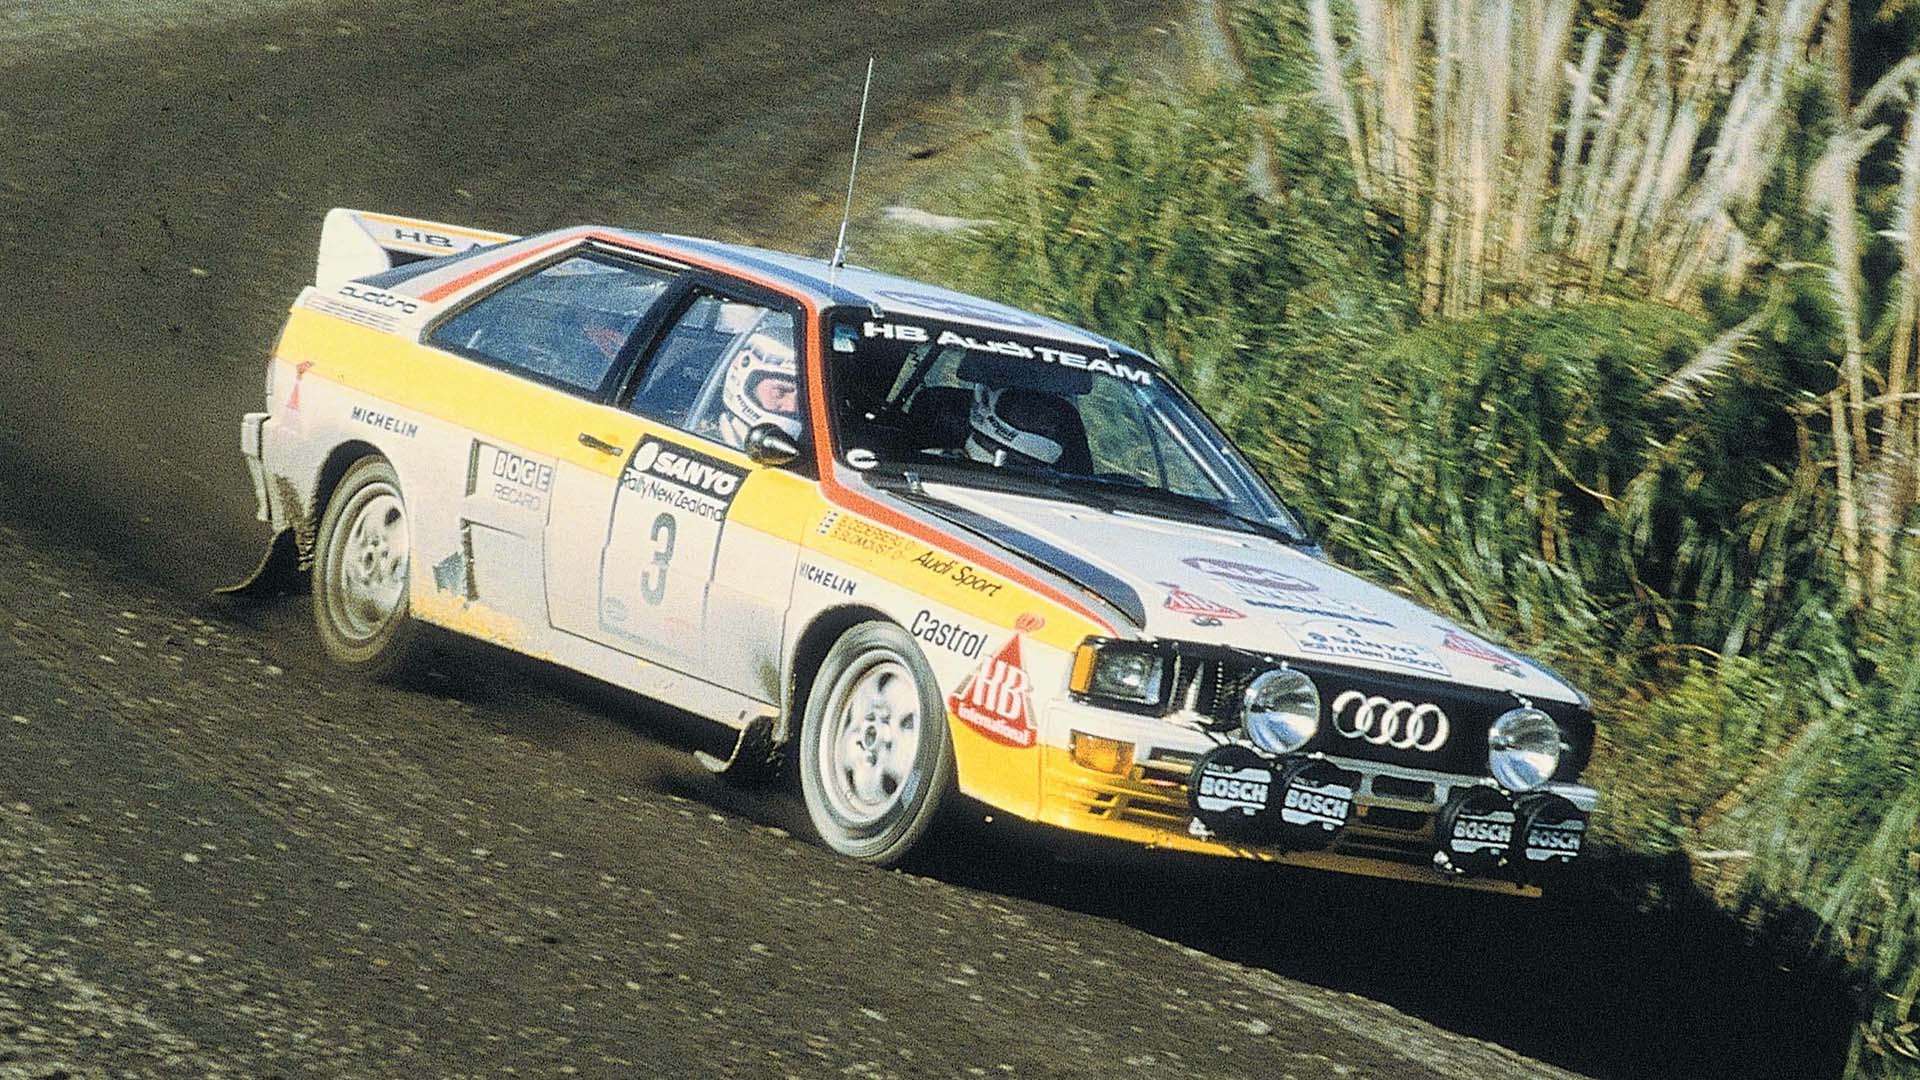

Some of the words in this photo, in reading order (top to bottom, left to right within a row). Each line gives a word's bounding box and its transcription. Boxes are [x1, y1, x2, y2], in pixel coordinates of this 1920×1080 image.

[395, 228, 453, 248] HB
[863, 321, 928, 342] HB
[1033, 345, 1151, 386] TEAM
[351, 405, 418, 438] MICHELIN
[493, 450, 553, 494] BOGE
[653, 451, 739, 495] SANYO
[648, 480, 675, 504] New
[674, 490, 725, 522] Zealand
[640, 512, 677, 607] 3
[911, 551, 954, 575] Audi
[951, 566, 1002, 597] Sport
[911, 610, 988, 660] Castrol
[971, 656, 1034, 721] HB
[1200, 776, 1269, 804] BOSCH
[1284, 789, 1350, 820] BOSCH
[1453, 820, 1513, 843] BOSCH
[1528, 829, 1581, 851] BOSCH
